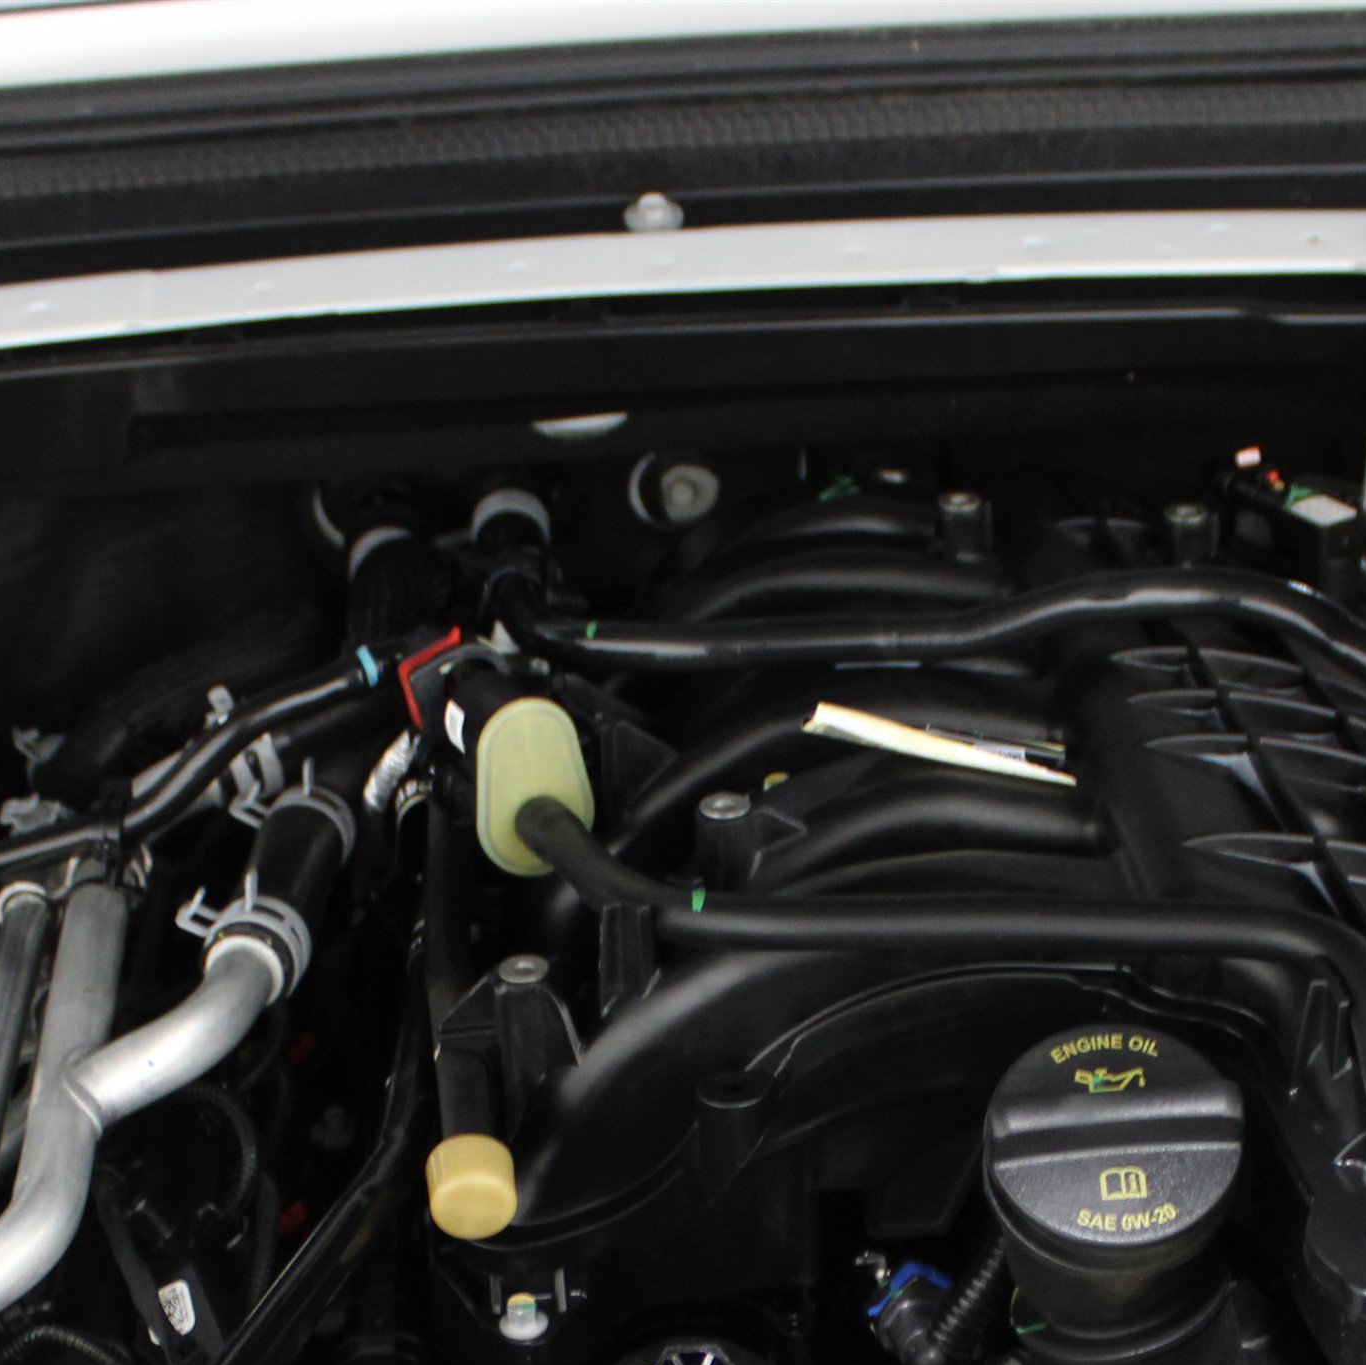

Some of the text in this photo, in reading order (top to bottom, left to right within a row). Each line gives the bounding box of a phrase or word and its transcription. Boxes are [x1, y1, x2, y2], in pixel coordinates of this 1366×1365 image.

[1050, 1033, 1159, 1064] ENGINE OIL
[1077, 1203, 1179, 1231] SAE 0W-20
